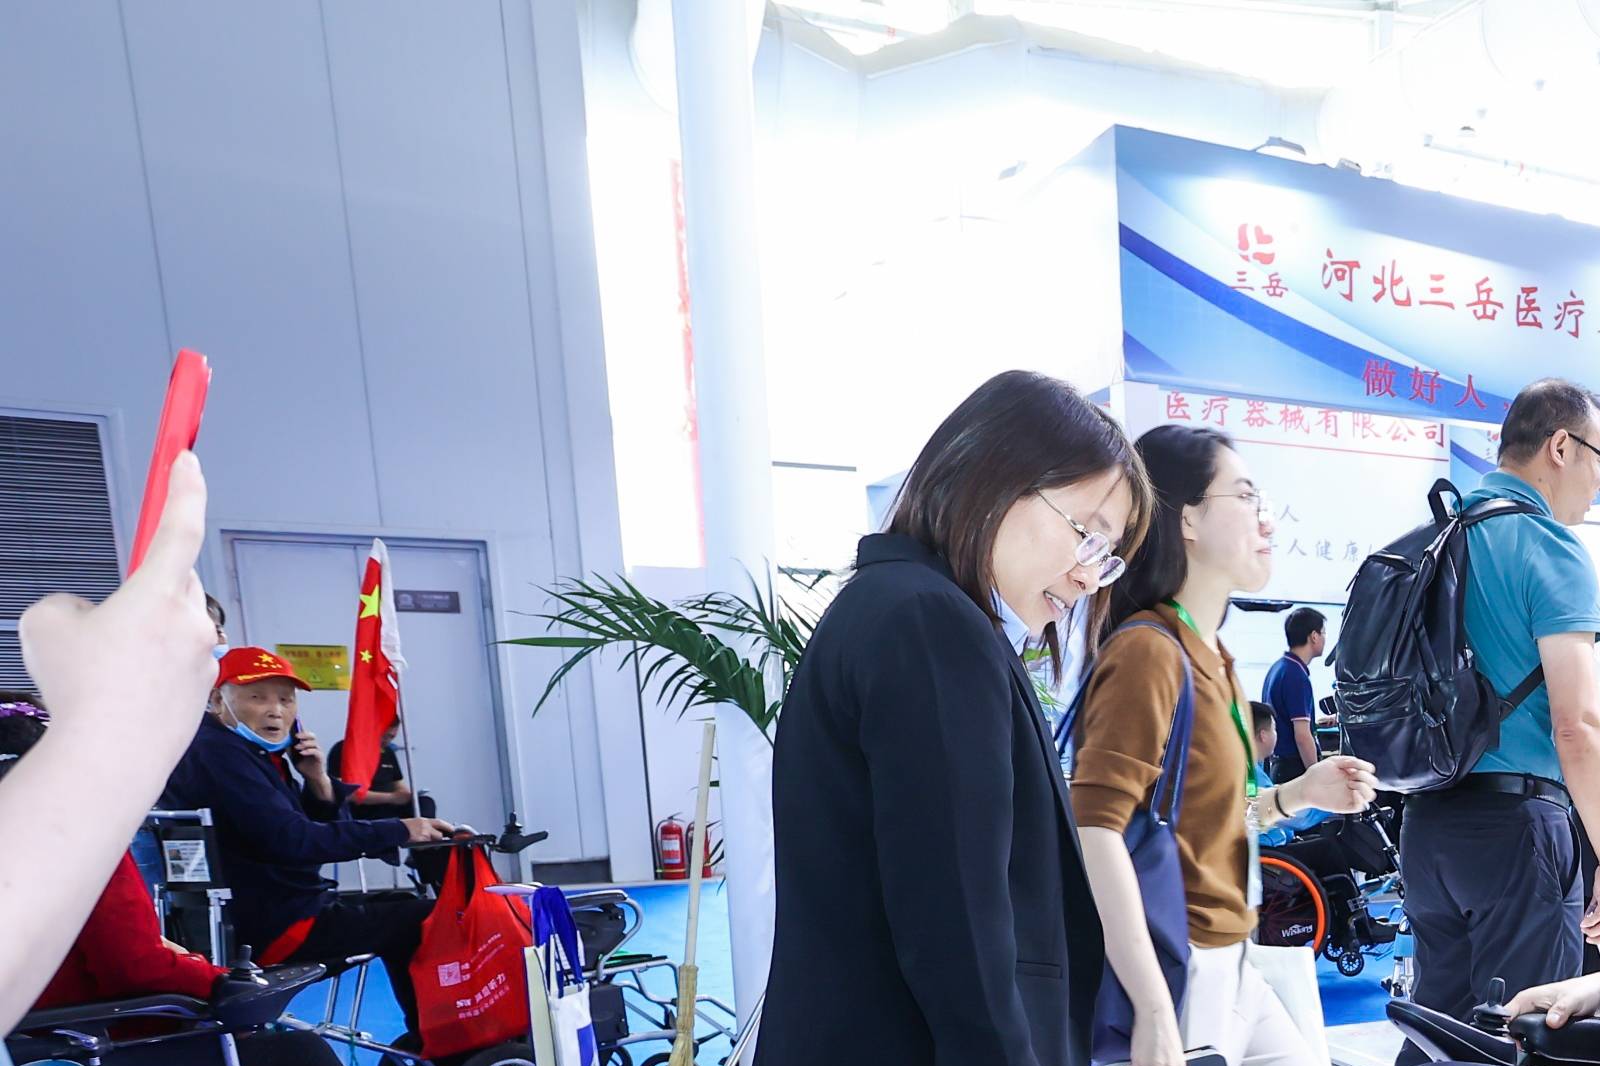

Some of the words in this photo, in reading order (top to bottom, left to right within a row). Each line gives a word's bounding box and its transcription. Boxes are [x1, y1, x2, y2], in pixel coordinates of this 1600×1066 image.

[1230, 271, 1288, 298] 三岳
[1165, 391, 1445, 448] 医疗器械有限公司
